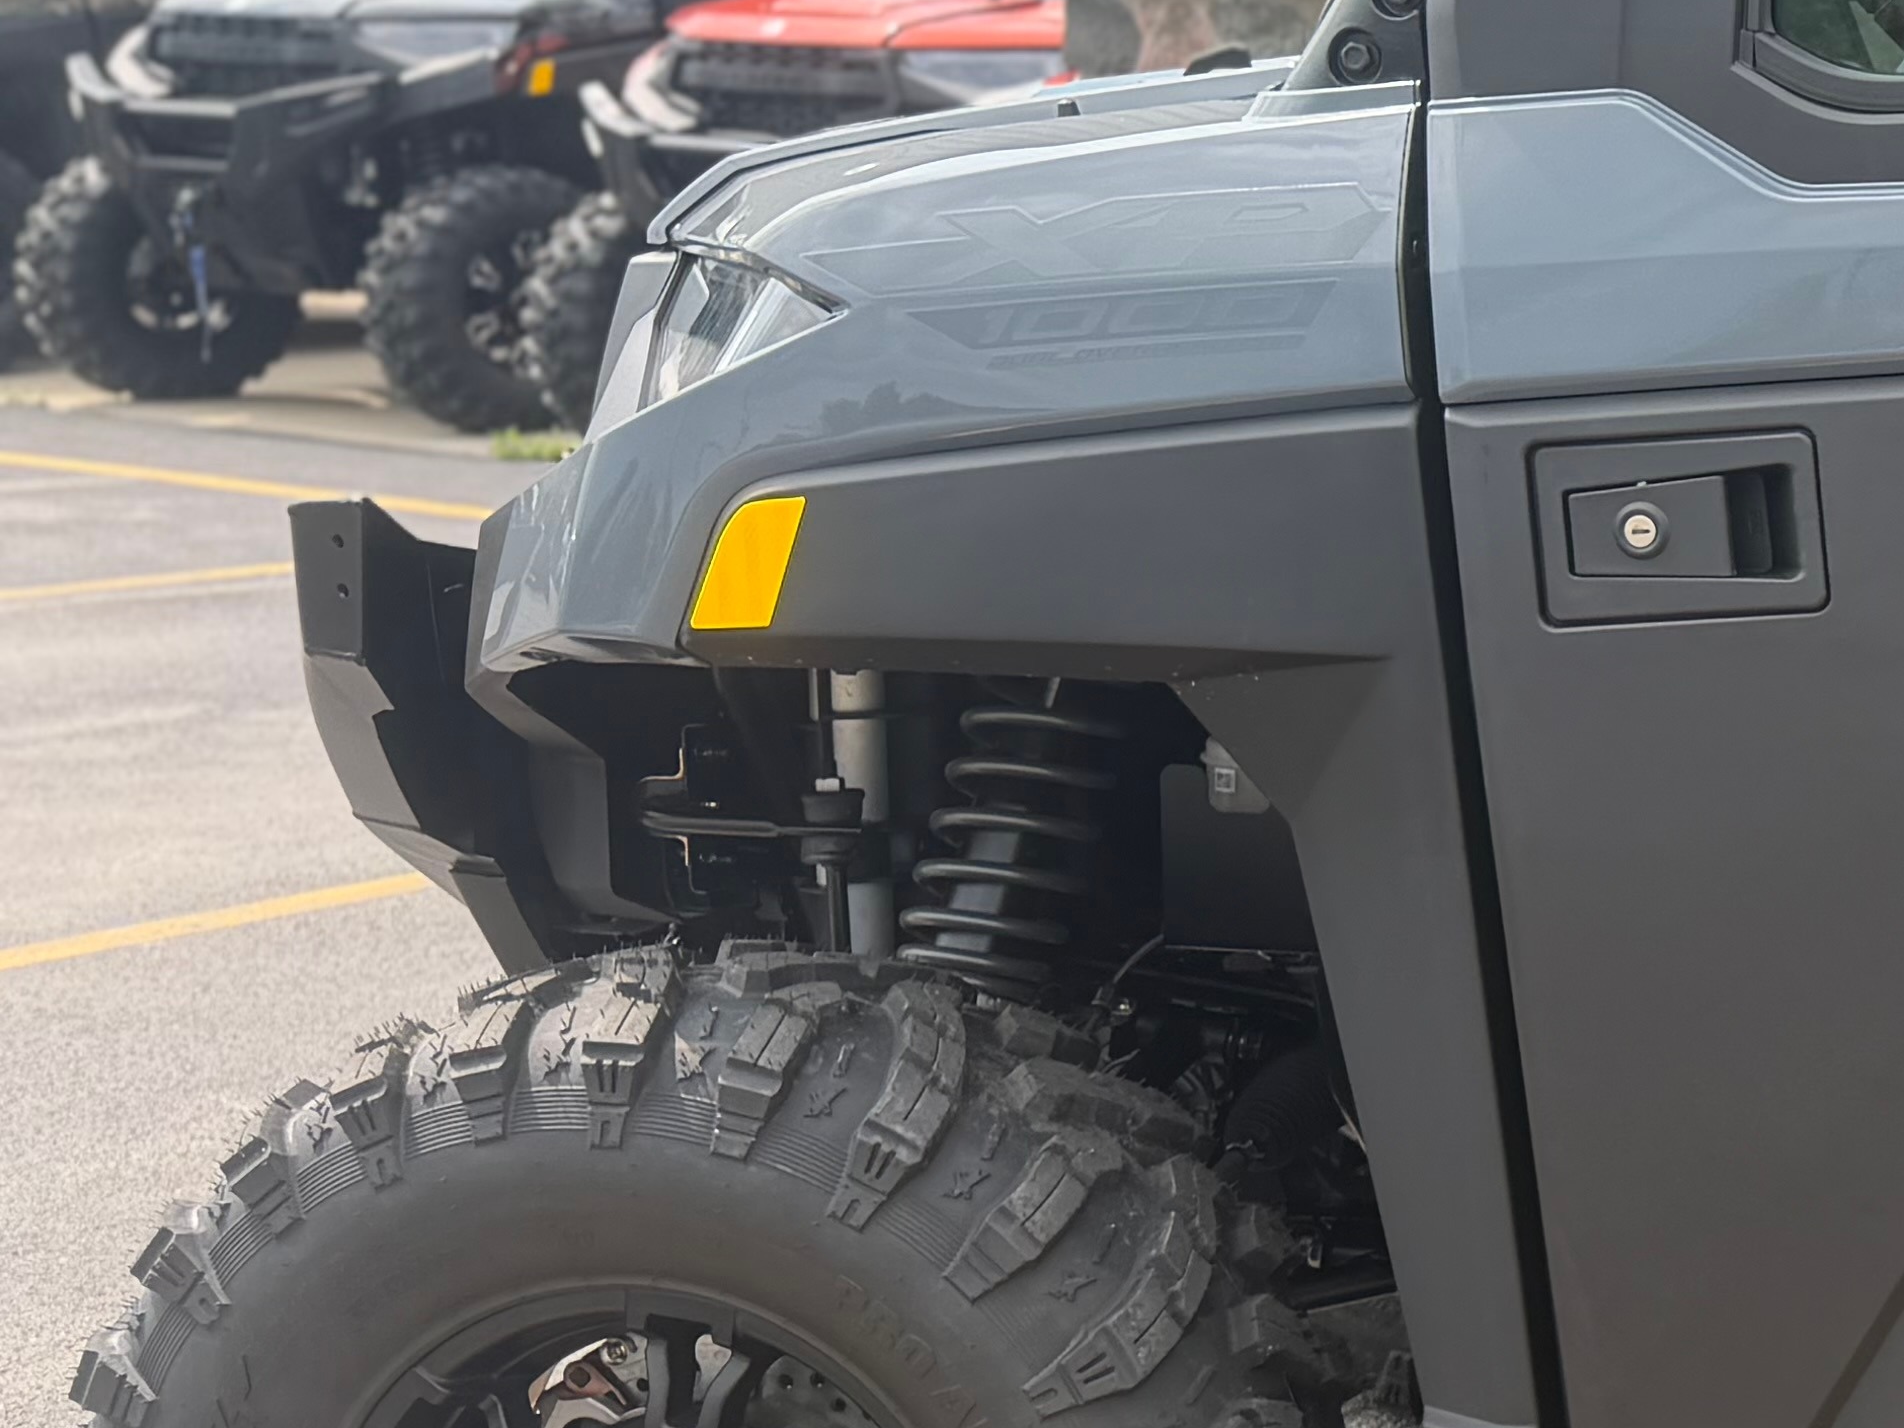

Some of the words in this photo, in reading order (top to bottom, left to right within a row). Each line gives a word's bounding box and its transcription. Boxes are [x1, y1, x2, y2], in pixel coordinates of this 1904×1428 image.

[802, 182, 1390, 297] XP
[978, 285, 1306, 348] 1000
[834, 1274, 938, 1379] PRO
